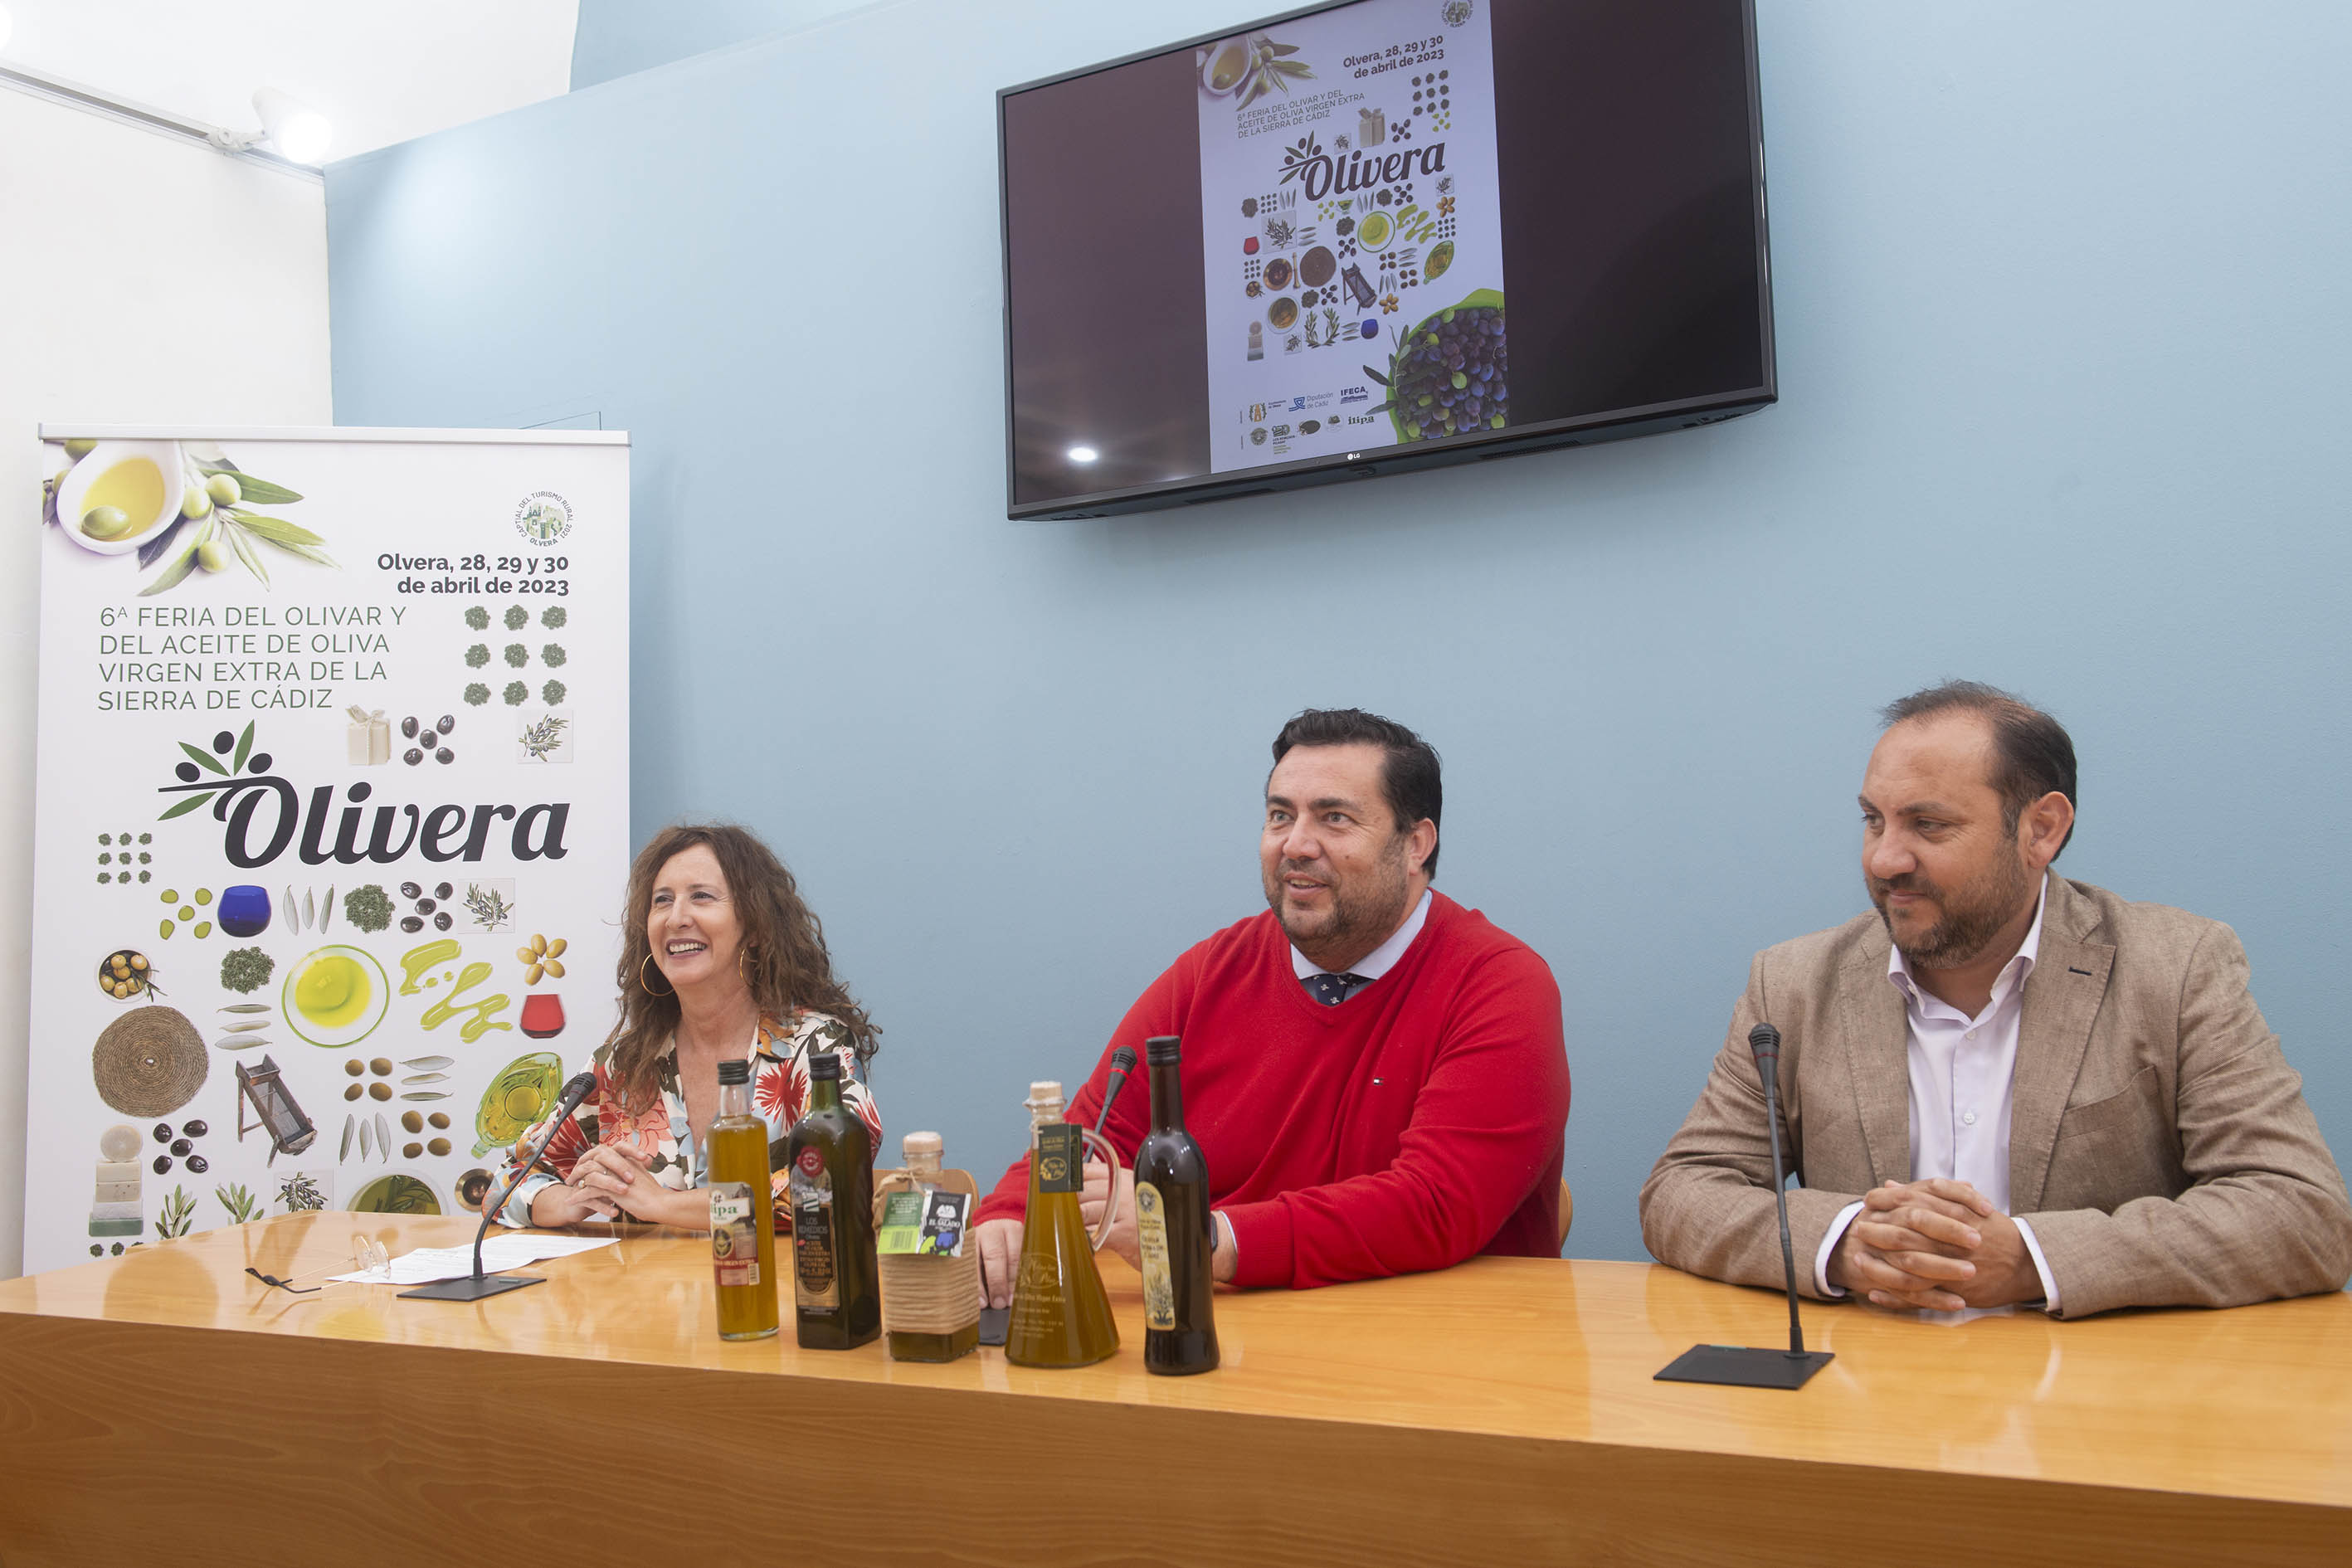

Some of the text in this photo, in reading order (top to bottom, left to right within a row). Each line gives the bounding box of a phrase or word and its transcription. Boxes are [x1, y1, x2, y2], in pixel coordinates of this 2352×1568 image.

[1343, 35, 1444, 68] Olvera, 28, 29 y 30
[1354, 49, 1444, 79] de abril de 2023
[1238, 92, 1365, 130] ACEITE DE OLIVA VIRGEN EXTRA
[1247, 107, 1270, 119] FERIA
[1272, 103, 1287, 114] DEL
[1288, 95, 1318, 109] OLIVAR
[1320, 94, 1326, 102] Y
[1327, 89, 1344, 100] DEL
[1238, 129, 1249, 139] DE
[1250, 125, 1261, 136] LA
[1263, 119, 1291, 134] SIERRA
[1293, 114, 1304, 125] DE
[1300, 142, 1445, 202] Olivera
[1341, 387, 1366, 396] IFECA
[1348, 416, 1374, 425] ilipa
[519, 498, 532, 509] DEL
[531, 490, 563, 502] TURISMO
[561, 499, 573, 522] RURAL
[560, 523, 572, 538] 2021
[529, 538, 558, 547] OLVERA
[377, 553, 569, 575] Olvera, 28, 29 y 30
[397, 577, 569, 597] de abril de 2023
[138, 606, 216, 626] FERIA
[226, 607, 276, 626] DEL
[285, 606, 382, 626] OLIVAR
[390, 606, 407, 626] Y
[100, 634, 390, 655] DEL ACEITE DE OLIVA
[99, 661, 387, 683] VIRGEN EXTRA DE LA
[97, 684, 333, 711] SIERRA DE CÁDIZ
[212, 776, 572, 869] Olivera
